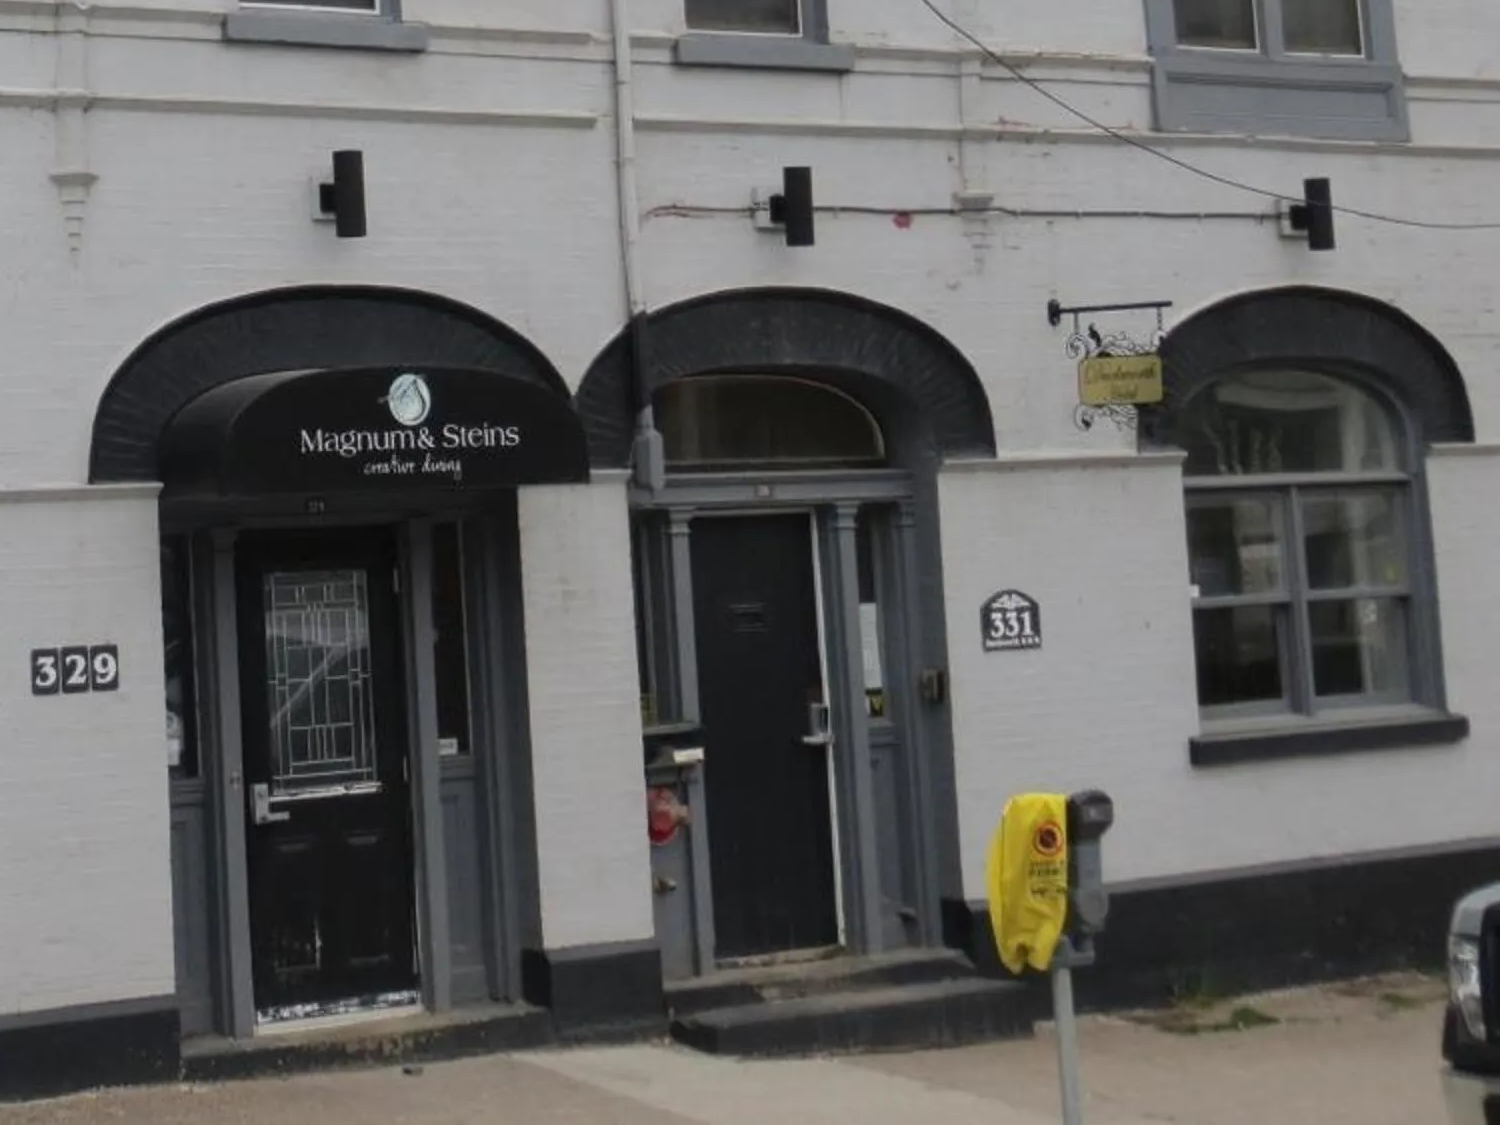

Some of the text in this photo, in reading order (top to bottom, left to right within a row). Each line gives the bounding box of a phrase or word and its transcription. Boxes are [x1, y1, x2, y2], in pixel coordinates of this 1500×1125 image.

[443, 422, 520, 448] Steins
[990, 610, 1034, 637] 331
[35, 652, 117, 687] 329
